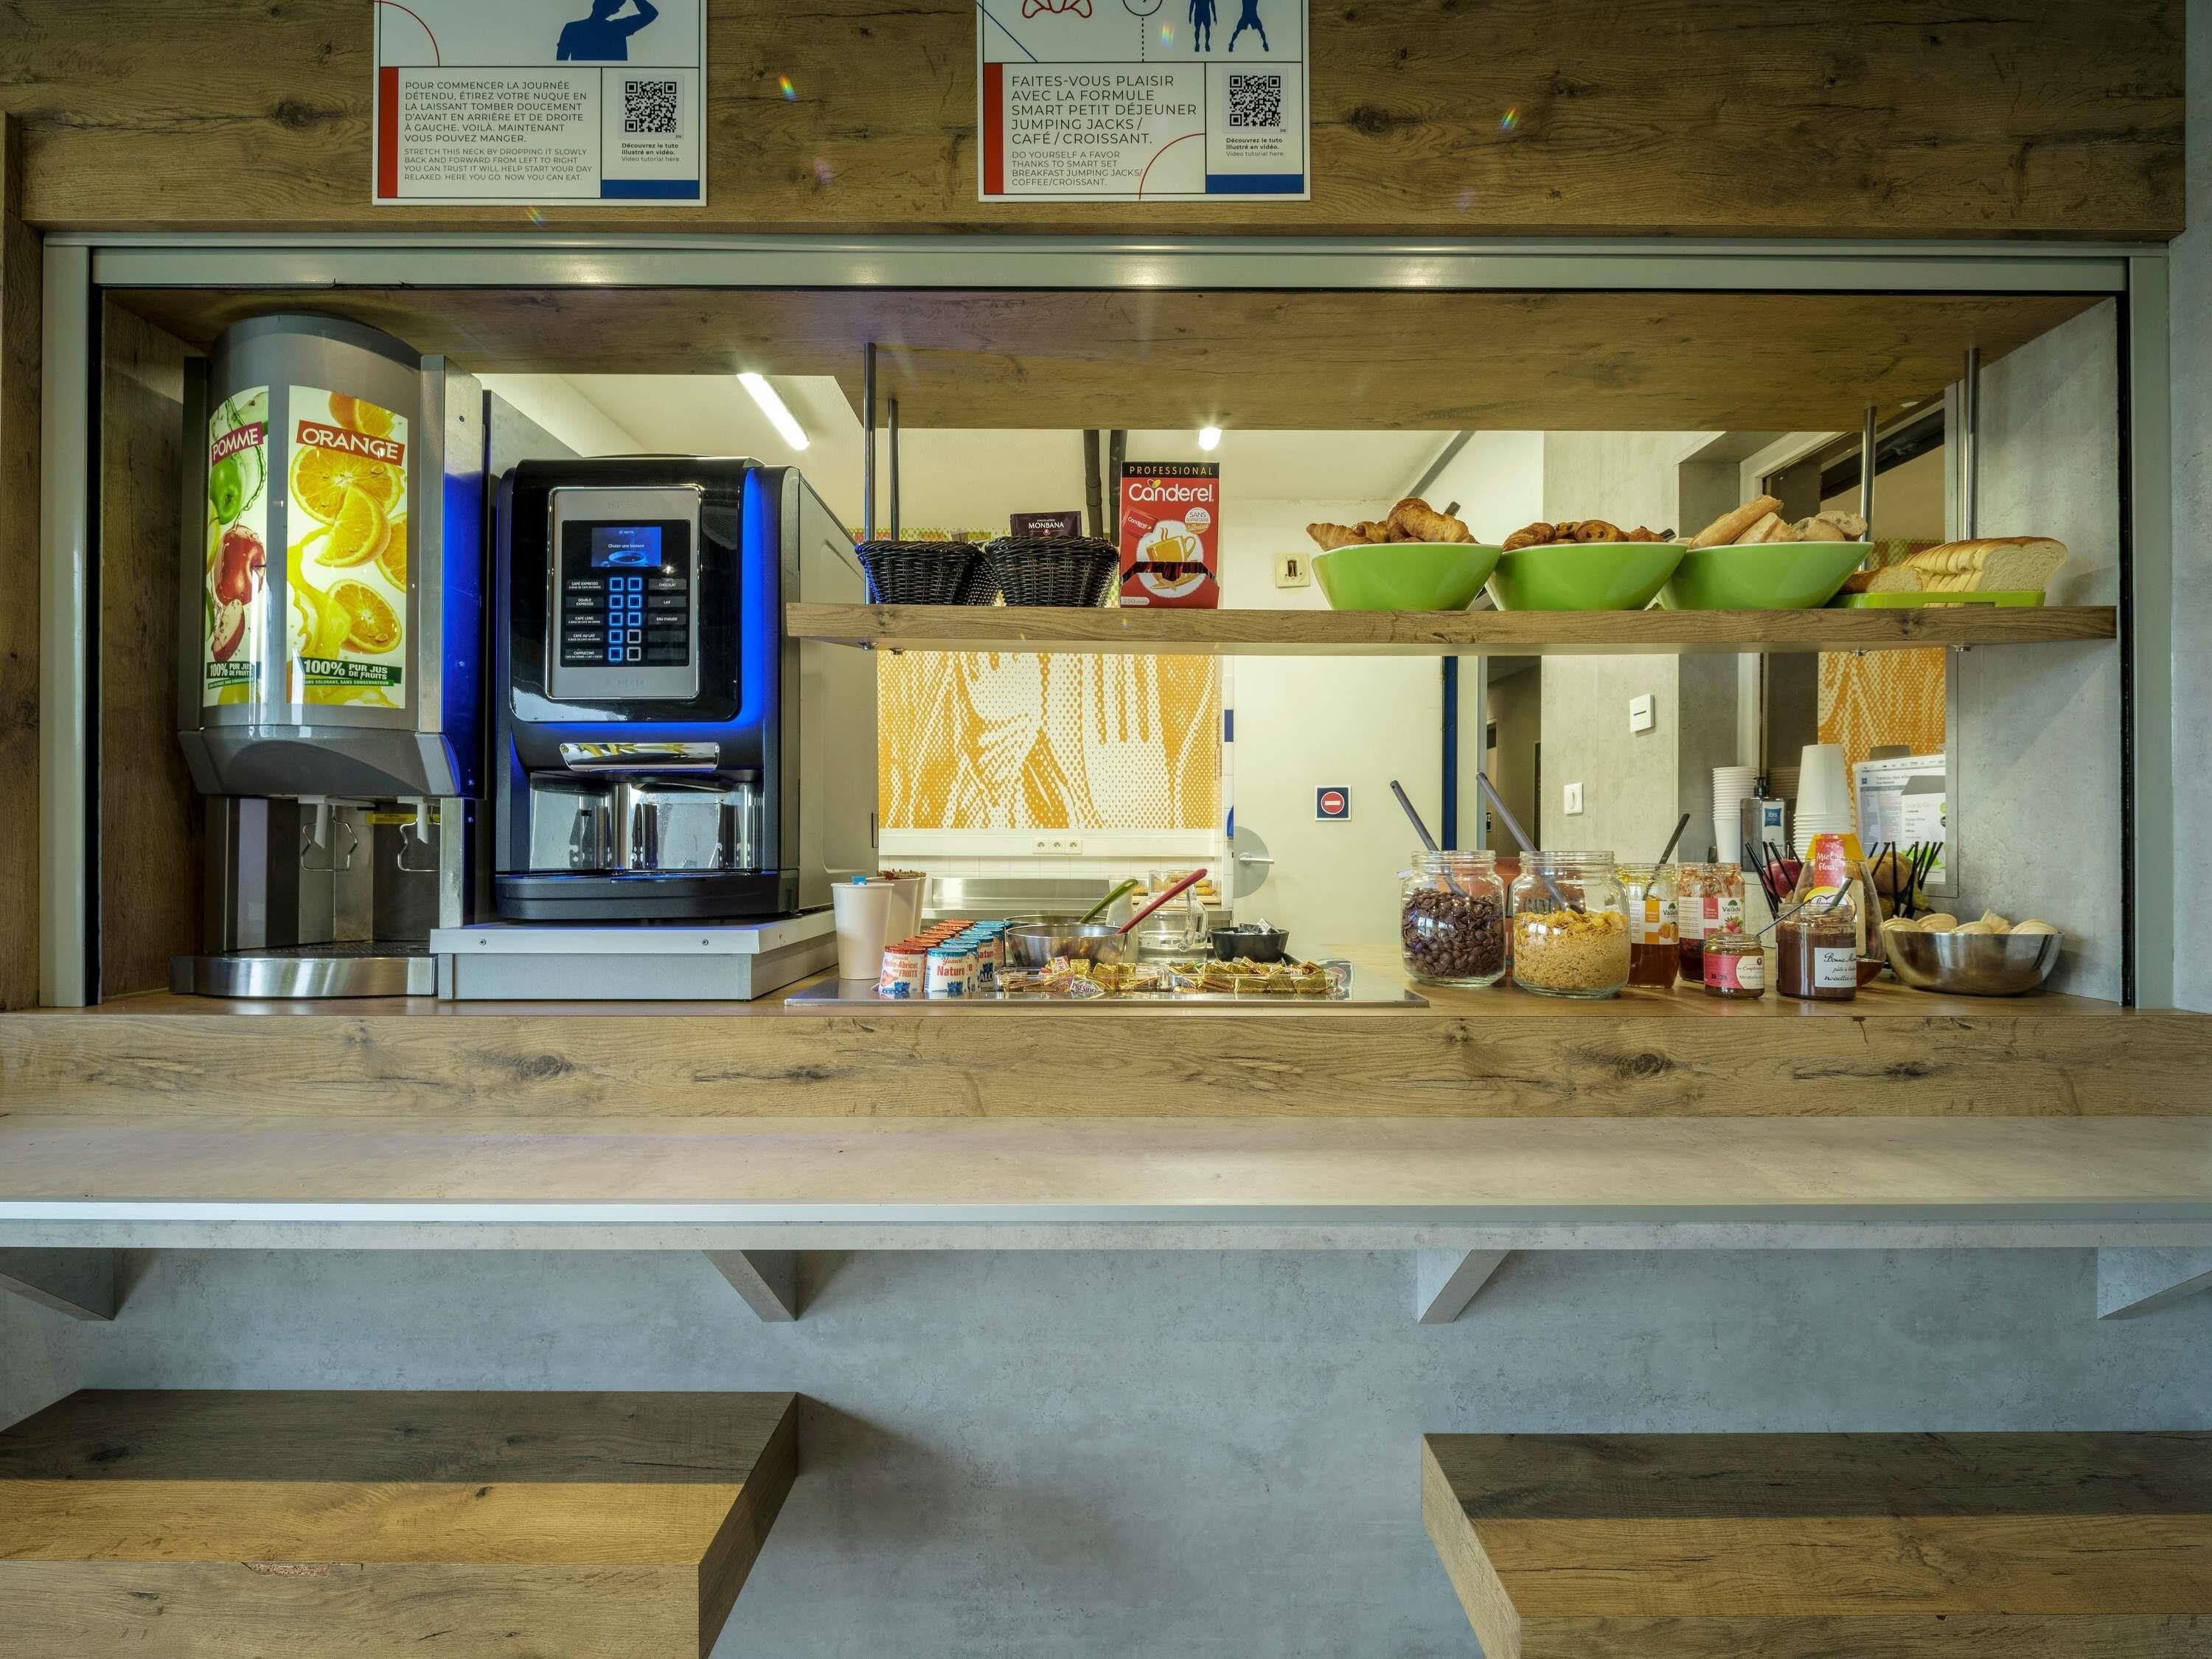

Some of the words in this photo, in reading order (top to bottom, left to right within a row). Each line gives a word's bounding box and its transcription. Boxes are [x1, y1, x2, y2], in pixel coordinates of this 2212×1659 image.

[522, 80, 570, 89] JOURNÉE
[1012, 76, 1110, 86] FAITES-VOUS
[1116, 76, 1174, 86] PLAISIR
[406, 91, 456, 101] DÉTENDU,
[459, 91, 494, 100] ÉTIREZ
[533, 92, 570, 101] NUQUE
[1012, 90, 1051, 101] AVEC
[1057, 90, 1075, 101] LA
[1080, 90, 1155, 101] FORMULE
[1012, 105, 1063, 115] SMART
[1069, 105, 1110, 115] PETIT
[1116, 102, 1197, 115] DÉJEUNER
[467, 112, 511, 121] ARRIÈRE
[405, 123, 411, 131] À
[1012, 119, 1082, 130] JUMPING
[212, 427, 259, 461] POMME
[302, 428, 398, 459] ORANGE
[1130, 466, 1213, 475] PROFESSIONAL
[210, 663, 228, 677] 100%
[304, 659, 346, 676] 100%
[348, 664, 368, 672] PUR
[369, 666, 388, 674] JUS
[361, 672, 387, 680] FRUITS
[1823, 952, 1846, 962] Bonne
[899, 969, 918, 978] FRUITS
[978, 972, 994, 982] ALO
